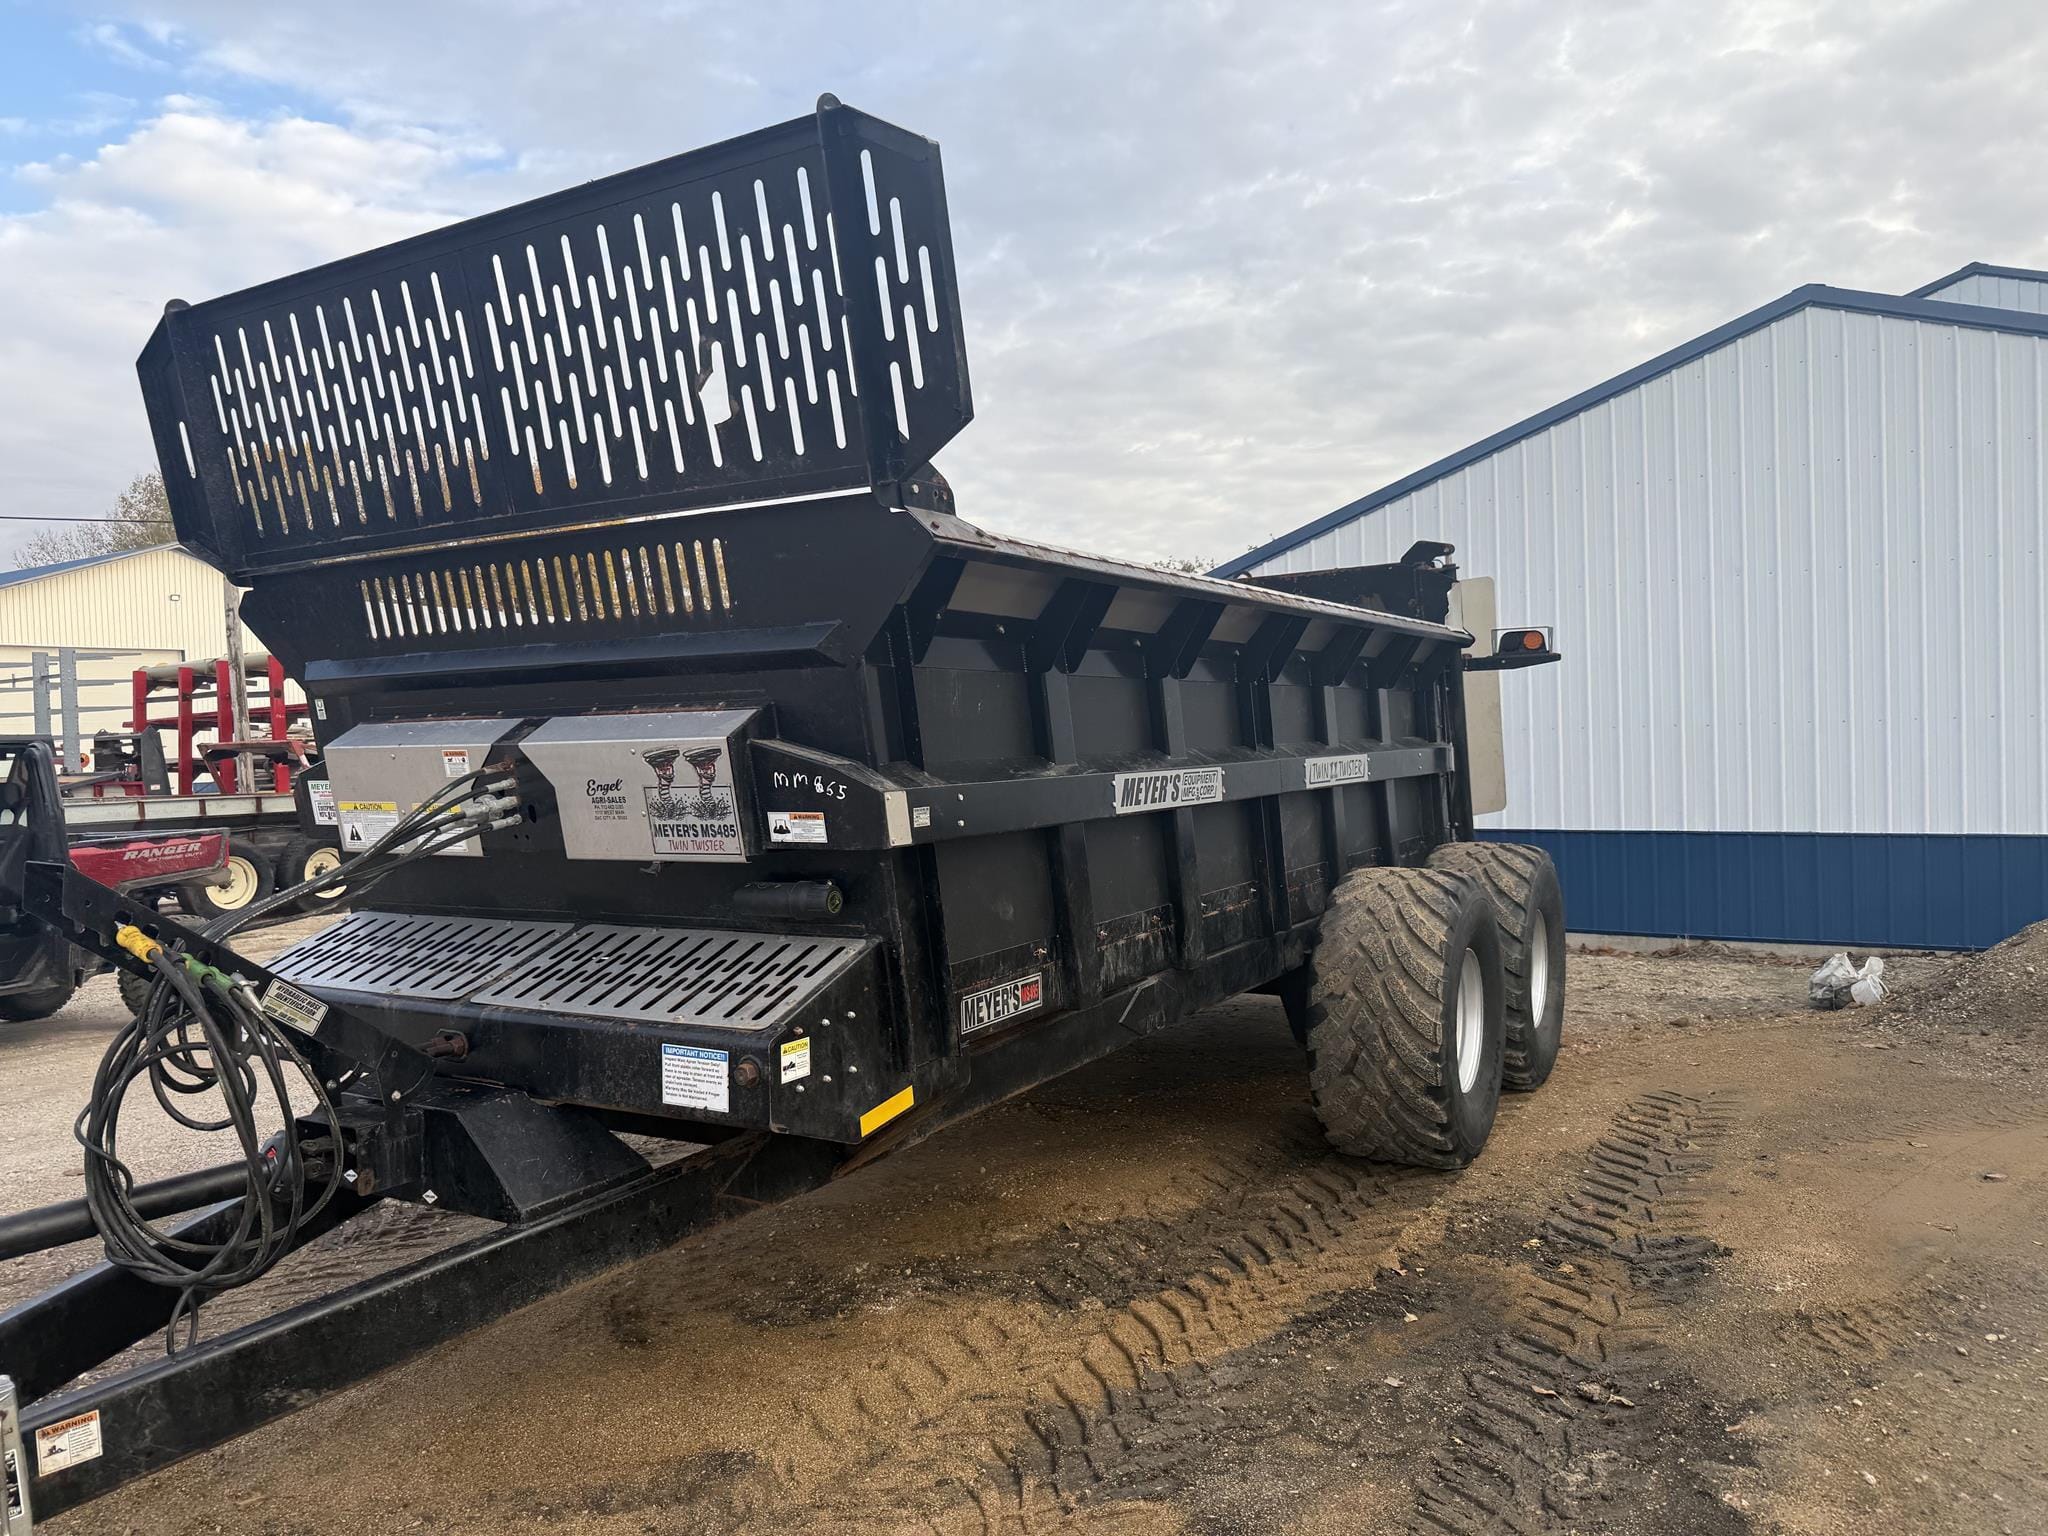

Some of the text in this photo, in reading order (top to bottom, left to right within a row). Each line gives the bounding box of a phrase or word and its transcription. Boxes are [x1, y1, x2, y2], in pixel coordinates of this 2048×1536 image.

[1312, 759, 1363, 780] TWIN TWISTER
[586, 778, 623, 797] Engel
[1183, 773, 1217, 786] EQUIPMENT
[591, 796, 627, 804] AGRI-SALES
[1120, 774, 1181, 808] MEYER'S
[360, 803, 383, 811] CAUTION
[653, 823, 736, 838] MEYER'S MS485
[123, 842, 202, 861] RANGER
[668, 839, 727, 852] TWIN TWISTER
[276, 984, 309, 1004] HYDRAULIC
[274, 991, 317, 1017] IDENTIFICATION
[964, 983, 1021, 1031] MEYER'S
[665, 1047, 700, 1058] IMPORTANT
[787, 1042, 808, 1053] CAUTION
[51, 1415, 93, 1433] WARNING
